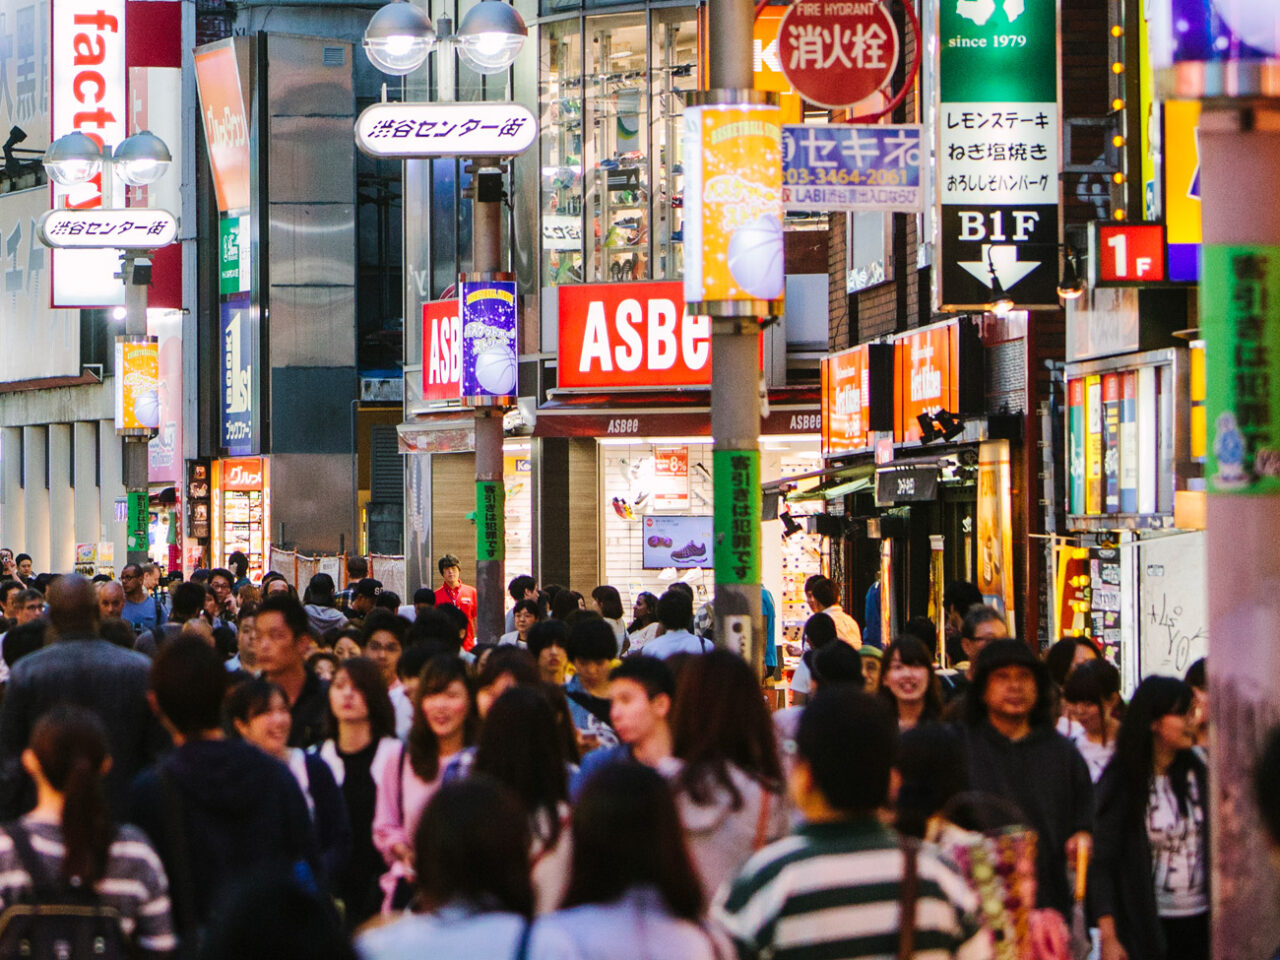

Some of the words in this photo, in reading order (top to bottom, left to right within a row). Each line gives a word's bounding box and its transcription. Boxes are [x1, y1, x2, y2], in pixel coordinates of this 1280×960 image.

[796, 2, 821, 17] FIRE
[824, 2, 875, 17] HYDRANT
[788, 23, 888, 70] 消火栓
[948, 35, 988, 48] since
[993, 34, 1027, 48] 1979
[62, 8, 120, 210] facty
[367, 117, 528, 138] 渋谷センター街
[946, 111, 1050, 130] レモンステーキ
[947, 142, 1048, 162] ねぎ塩焼き
[946, 174, 1049, 192] おろししそハンバーグ
[49, 219, 170, 237] 渋谷センター街
[957, 210, 1041, 241] B1F
[1107, 233, 1152, 278] 1F
